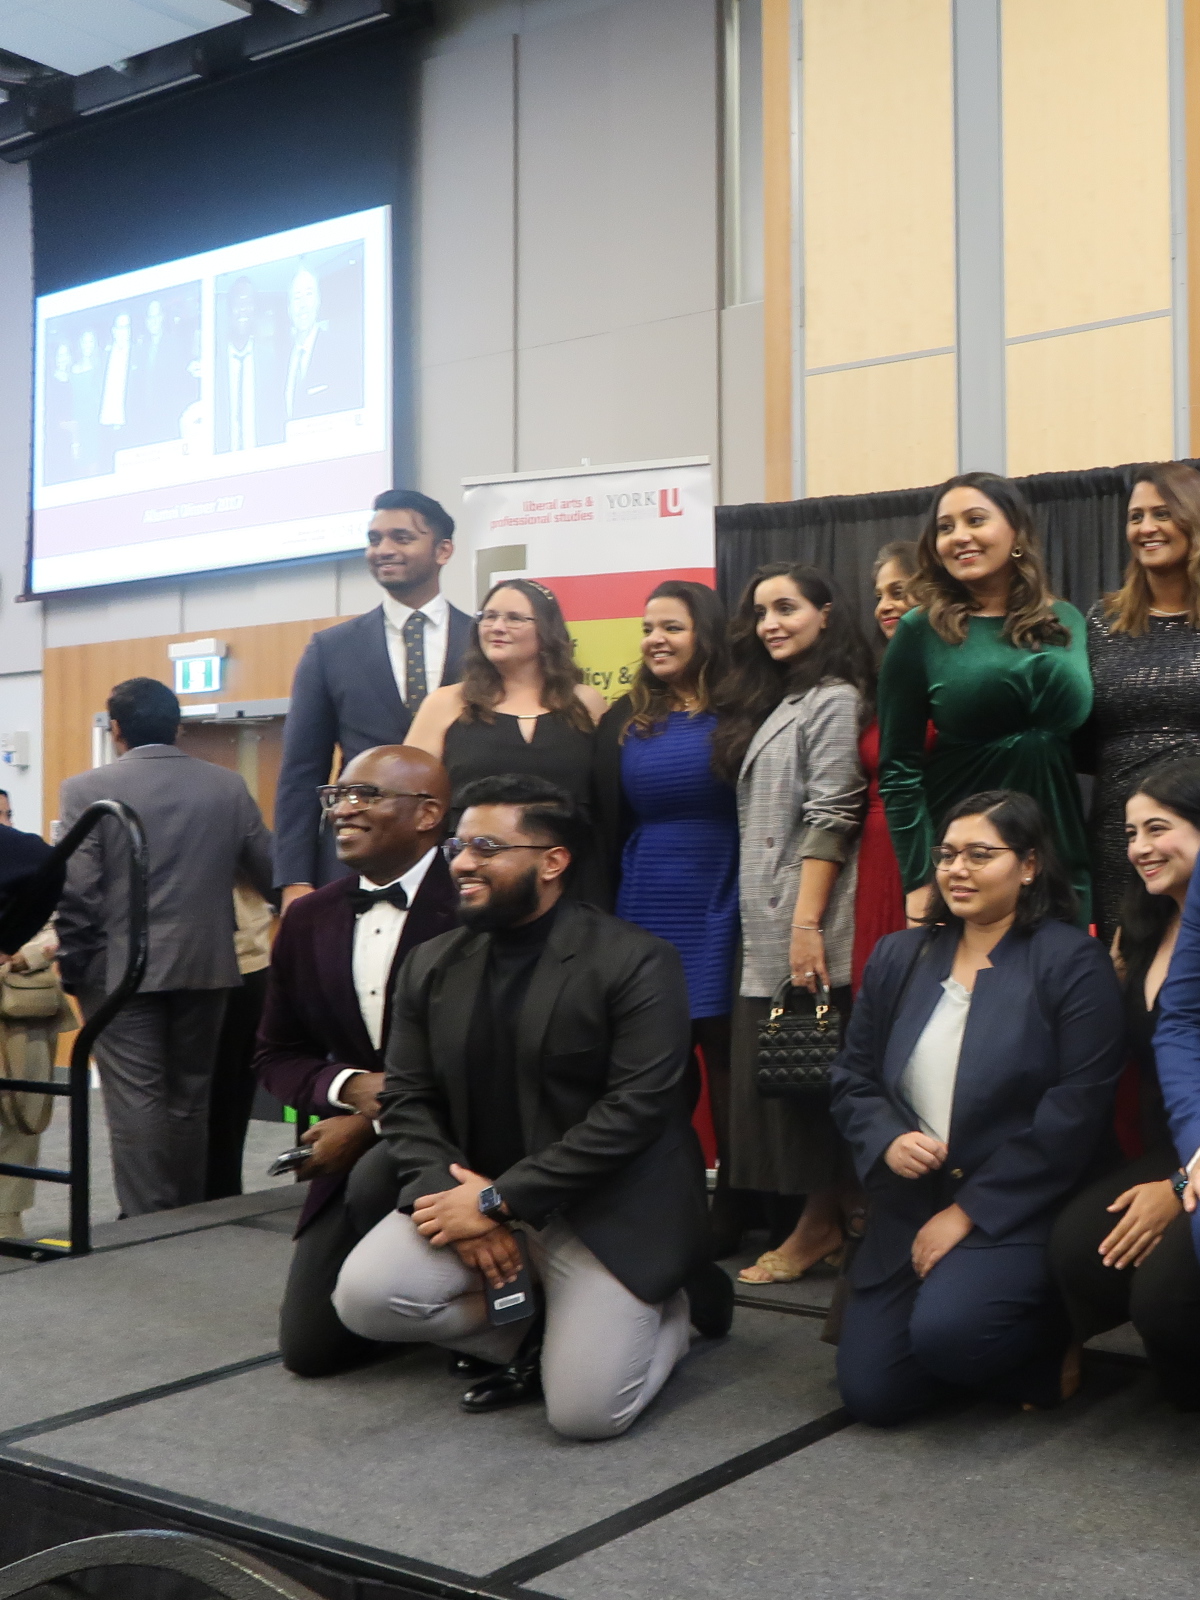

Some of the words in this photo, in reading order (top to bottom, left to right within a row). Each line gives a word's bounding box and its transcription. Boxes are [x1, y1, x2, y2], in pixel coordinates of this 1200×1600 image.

[522, 499, 558, 512] liberal
[560, 499, 583, 509] arts
[584, 496, 595, 507] &
[606, 491, 657, 509] YORK
[490, 513, 552, 531] professional
[553, 510, 595, 523] studies
[582, 668, 613, 690] licy
